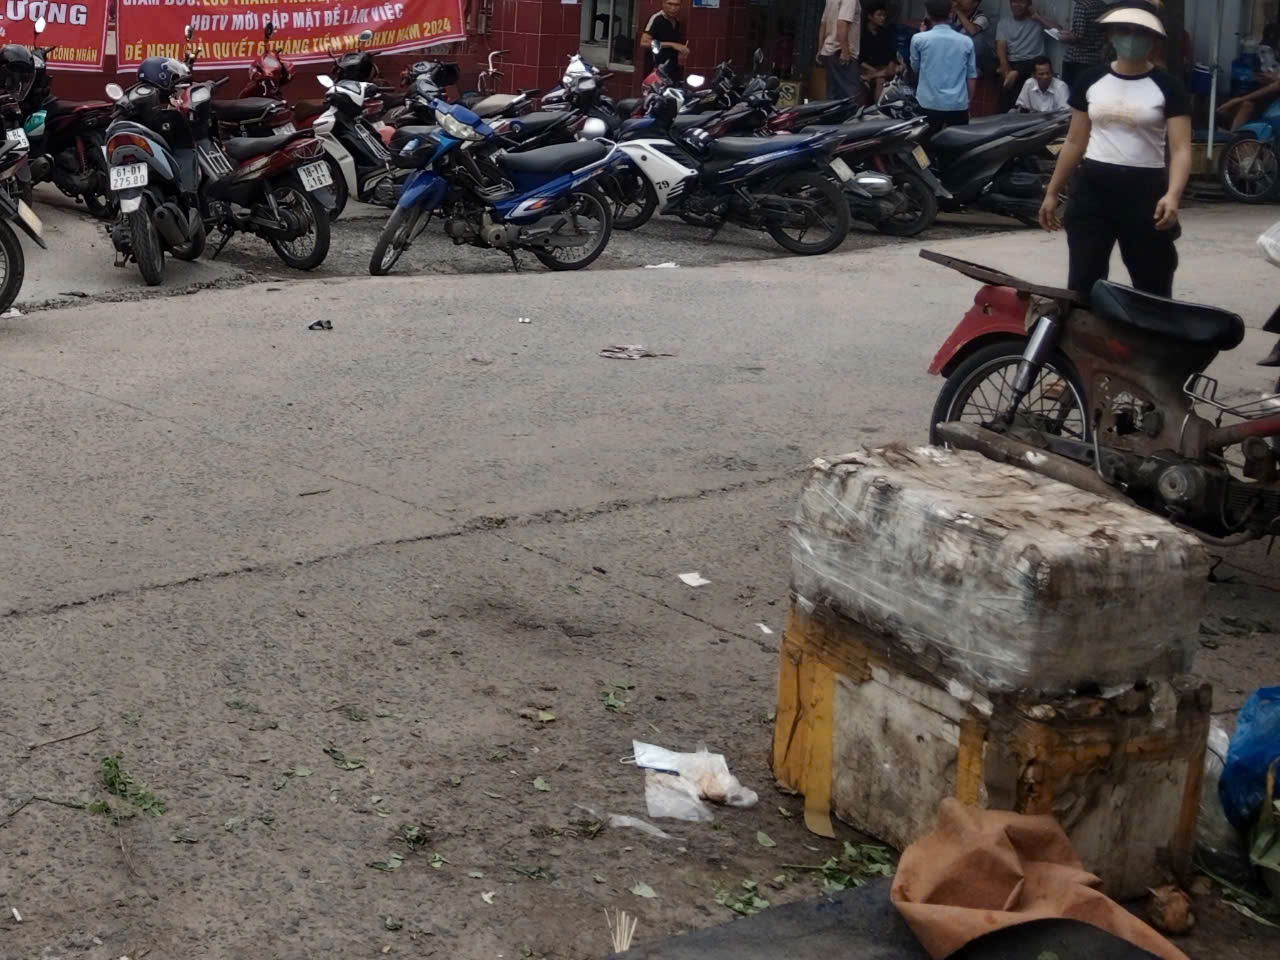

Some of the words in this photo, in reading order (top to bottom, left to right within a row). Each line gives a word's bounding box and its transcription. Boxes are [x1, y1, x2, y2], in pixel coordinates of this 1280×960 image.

[190, 14, 229, 32] HĐTV
[231, 9, 259, 31] MỚI
[292, 7, 321, 32] MẶT
[324, 3, 340, 26] ĐỂ
[342, 4, 370, 26] LÀM
[371, 1, 404, 25] VIỆC
[125, 38, 143, 61] ĐỀ
[212, 34, 255, 59] QUYẾT
[256, 40, 265, 57] 6
[423, 17, 452, 37] 2024
[53, 44, 74, 62] CÔNG
[75, 46, 98, 63] NHÂN
[116, 165, 141, 178] 61-D1
[655, 179, 671, 190] 79
